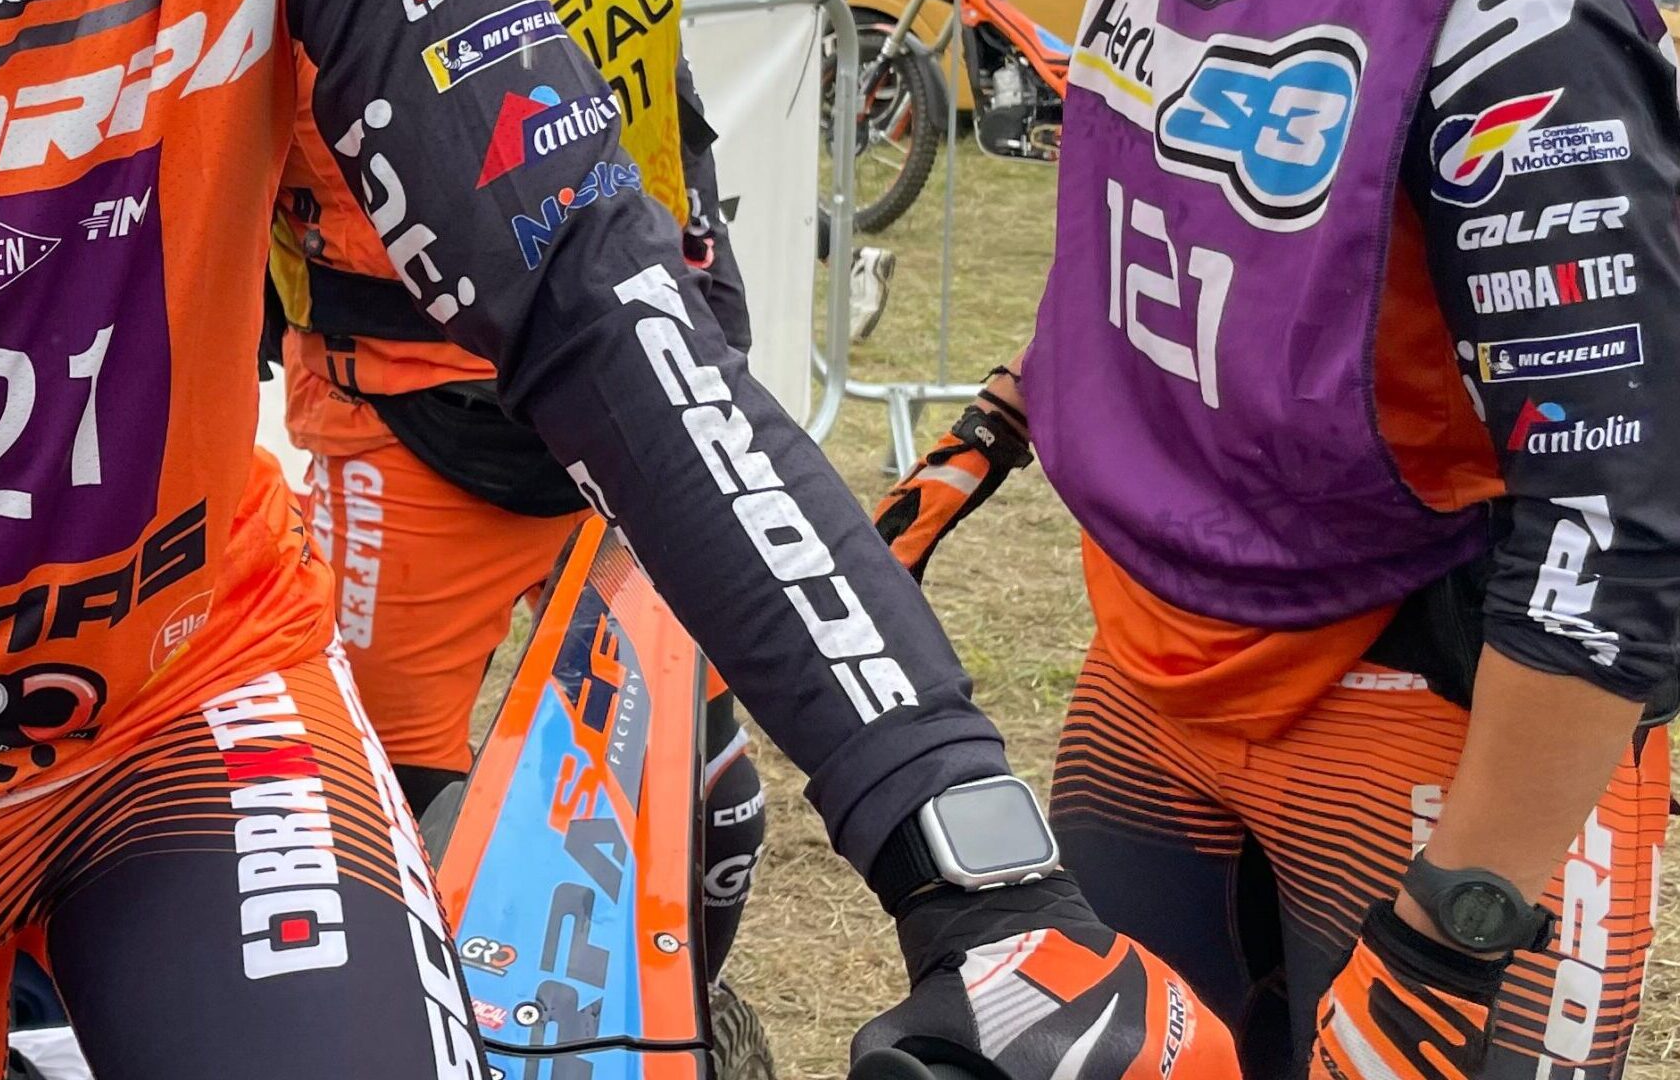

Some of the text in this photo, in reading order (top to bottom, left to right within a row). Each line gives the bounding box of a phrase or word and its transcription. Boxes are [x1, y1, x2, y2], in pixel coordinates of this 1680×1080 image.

[1161, 59, 1360, 198] S3
[1528, 127, 1614, 153] Femenina
[1511, 143, 1629, 173] Motociclismo
[77, 185, 152, 241] FIM
[1456, 195, 1631, 251] GALFER
[1106, 177, 1234, 410] 121
[1517, 340, 1627, 368] MICHELIN
[1526, 414, 1642, 455] antolin
[612, 263, 921, 725] SCORPA
[340, 460, 383, 649] GALFER
[610, 668, 642, 767] FACTORY
[460, 935, 518, 969] GRO
